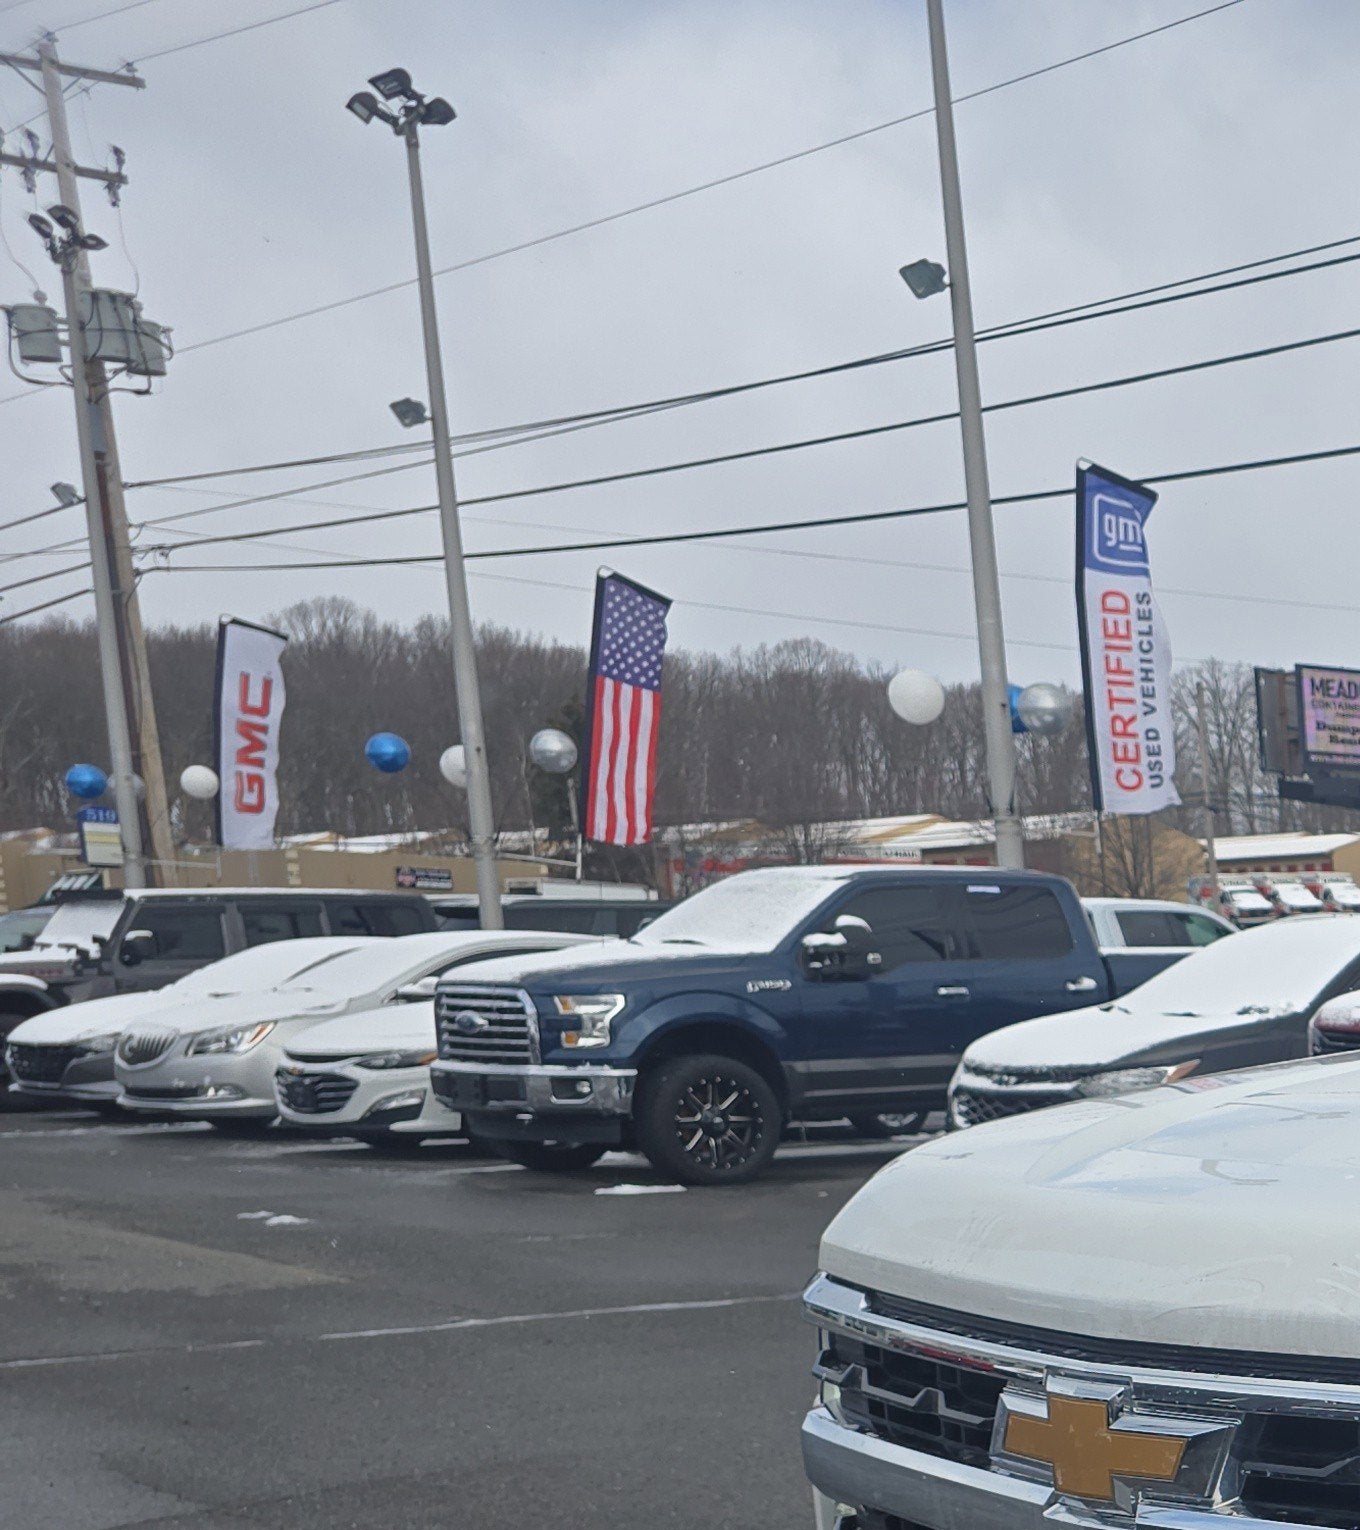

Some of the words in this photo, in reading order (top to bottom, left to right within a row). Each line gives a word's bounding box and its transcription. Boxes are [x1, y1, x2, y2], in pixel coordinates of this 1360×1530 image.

[1104, 512, 1143, 552] gm
[1101, 588, 1145, 793] CERTIFIED
[1135, 590, 1156, 716] VEHICLES
[235, 671, 273, 815] GMC
[1141, 727, 1164, 789] USED
